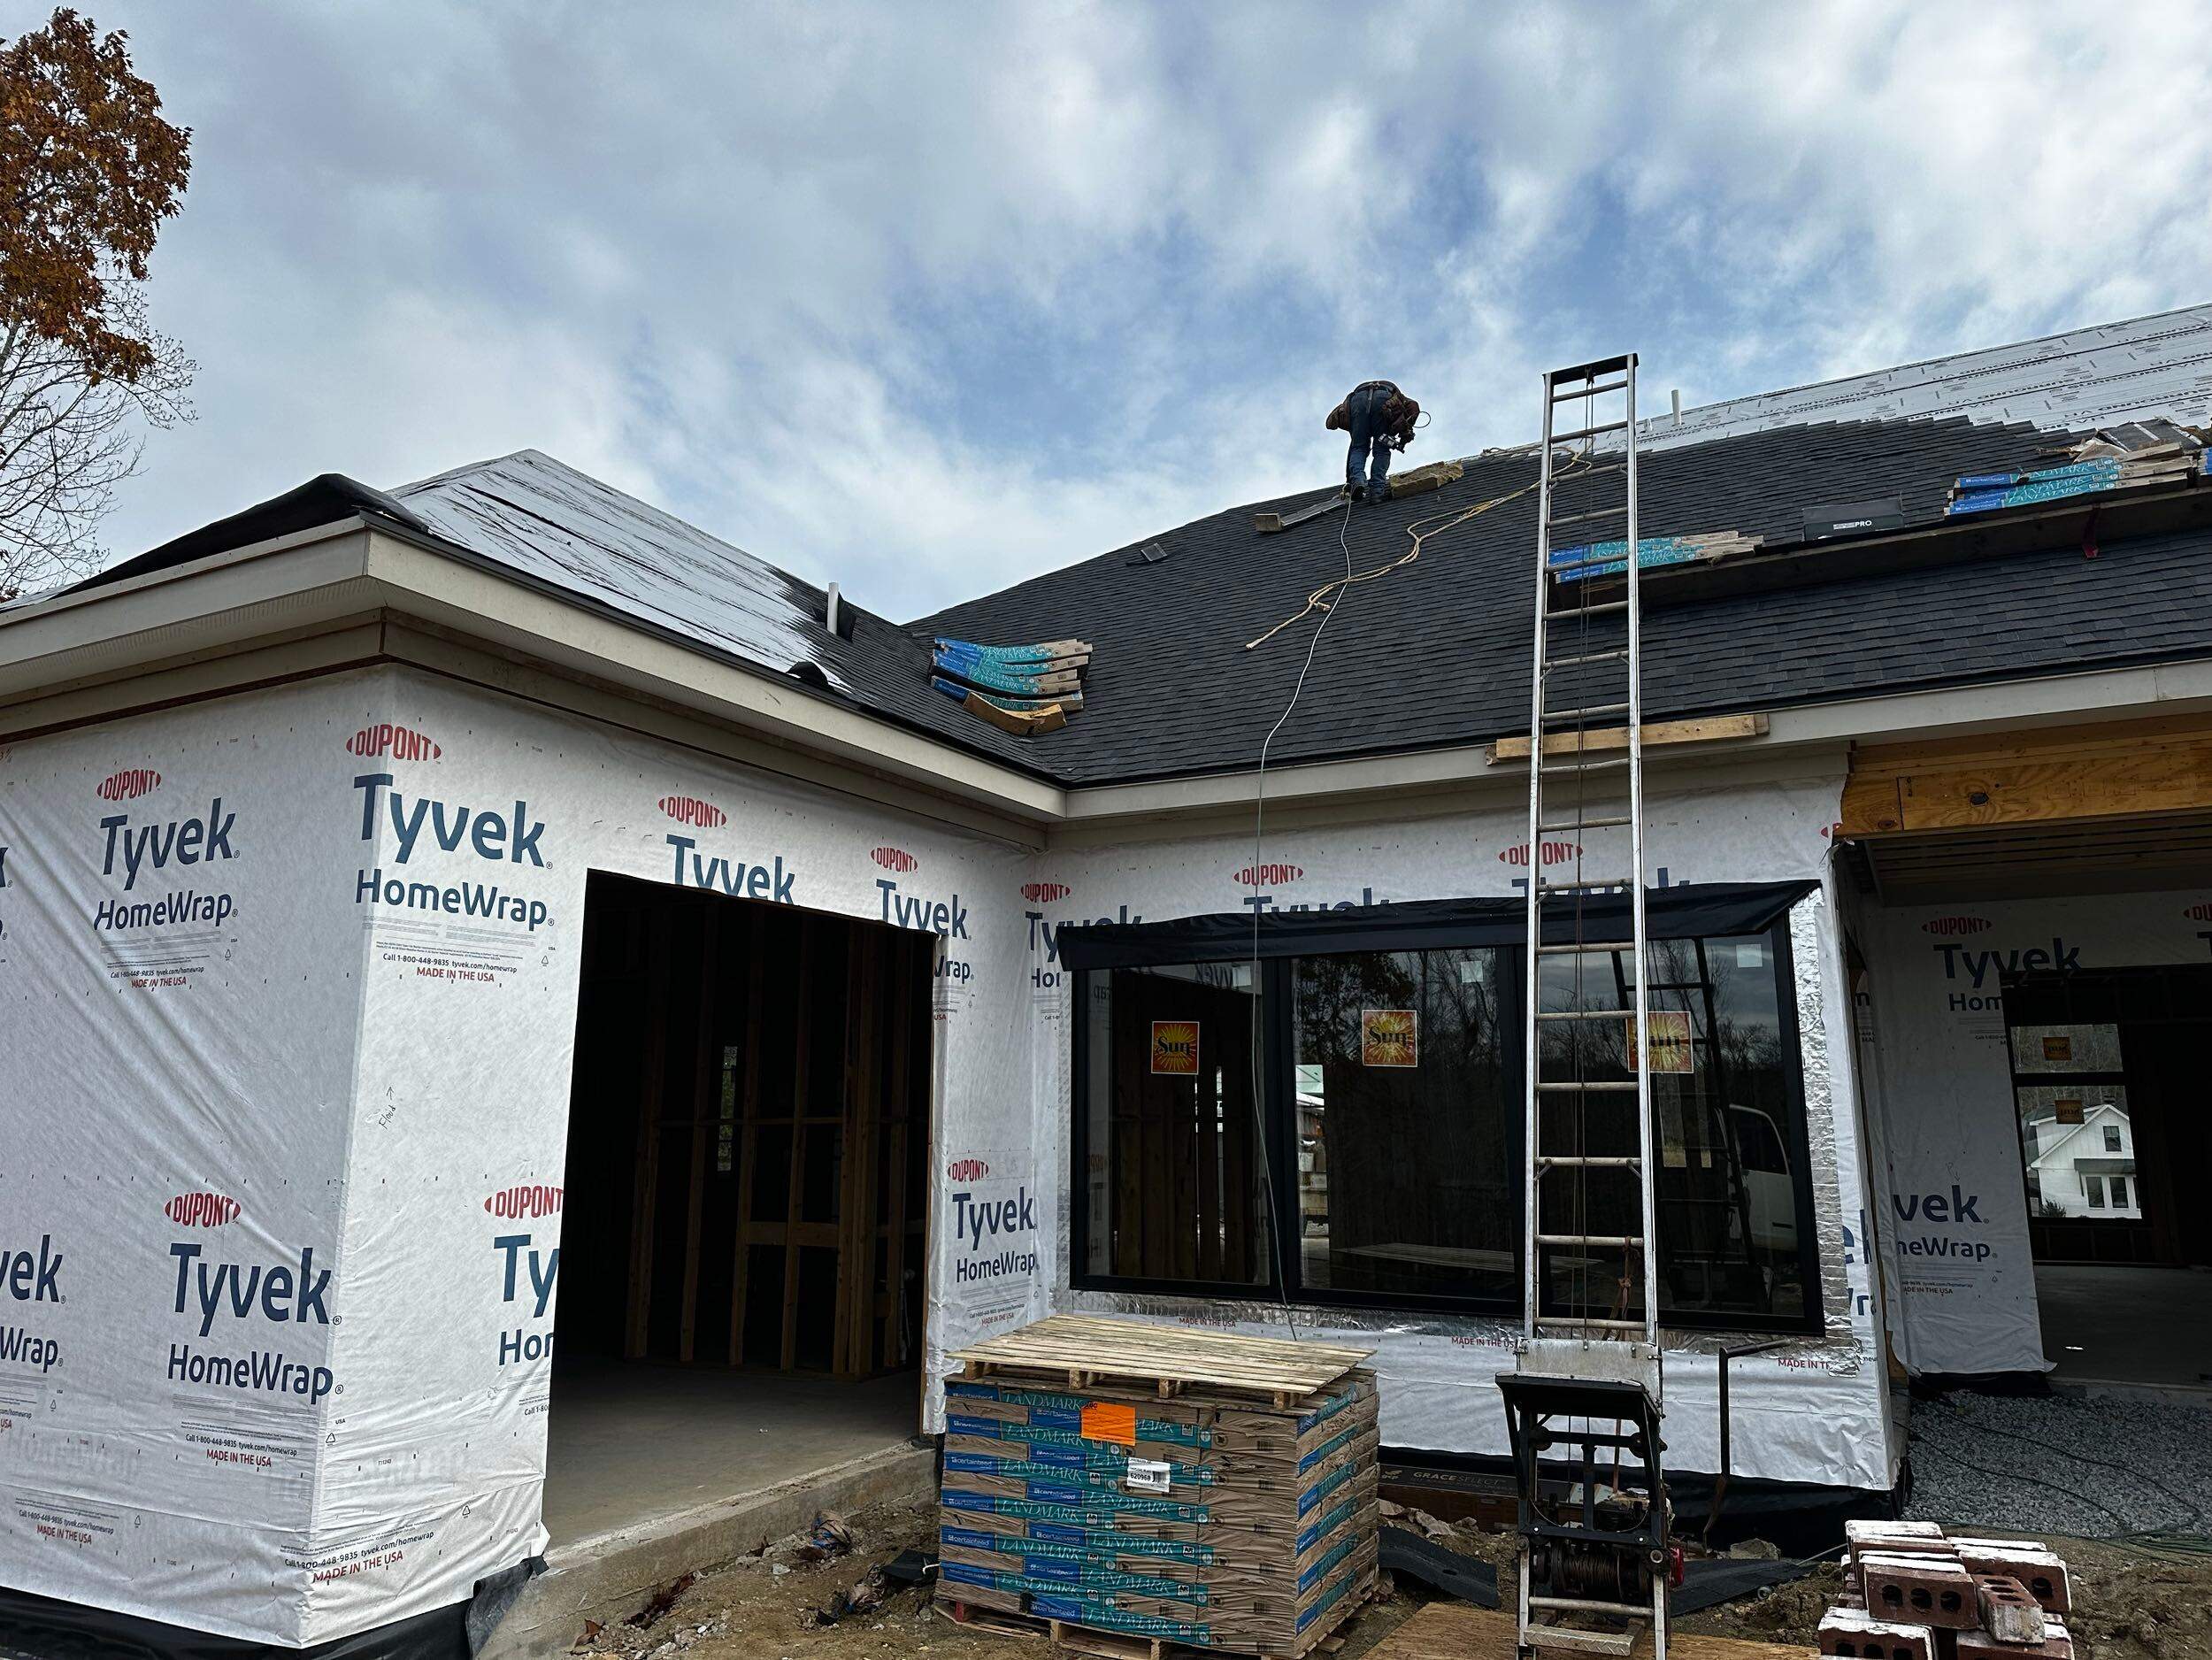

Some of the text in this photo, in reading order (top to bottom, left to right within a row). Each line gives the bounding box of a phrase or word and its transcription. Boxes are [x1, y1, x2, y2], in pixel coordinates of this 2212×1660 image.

[355, 724, 432, 761] DUPONT
[104, 770, 156, 801] DUPONT
[354, 772, 546, 868] Tyvek
[666, 796, 720, 827] DUPONT
[100, 797, 236, 891] Tyvek
[1509, 842, 1573, 866] DUONT
[876, 847, 914, 872] DUPONT
[1242, 864, 1296, 886] DUPONT
[355, 868, 547, 932] HomeWrap
[1025, 884, 1064, 903] DUPONT
[94, 890, 233, 931] HomeWrap
[1931, 917, 1984, 935] DUPONT
[382, 953, 518, 973] Call 1-800-448-9835 tyvek.com/homewrap
[417, 966, 495, 983] MADE IN THE USA
[131, 976, 187, 988] MADE IN THE USA
[1157, 1035, 1191, 1057] Sun
[1368, 1026, 1409, 1047] Sun
[952, 1159, 985, 1182] DUPONT
[173, 1193, 233, 1228] DUPONT
[495, 1186, 565, 1219] DUPONT
[952, 1187, 1033, 1251] Tyvek
[956, 1250, 1035, 1283] HomeWrap
[169, 1242, 332, 1337] Tyvek
[168, 1343, 334, 1405] HomeWrap
[1778, 1358, 1806, 1369] MADE
[1809, 1359, 1817, 1369] IN
[1005, 1394, 1083, 1410] LANDMARK
[186, 1433, 297, 1456] Call 1-800-448-9835 tyvek.com/homewrap
[1005, 1426, 1084, 1447] LANDMARK
[206, 1449, 272, 1467] MADE IN THE USA
[1004, 1460, 1082, 1483] LANDMARK
[1413, 1472, 1458, 1482] GRACE
[1002, 1501, 1079, 1522] LANDMARK
[1087, 1490, 1170, 1515] LANDMARK
[37, 1525, 92, 1545] MADE IN THE USA
[1093, 1533, 1175, 1555] LANDMARK
[284, 1558, 296, 1567] Call
[296, 1552, 358, 1570] 1-800-448-9835
[361, 1531, 434, 1557] tyvek.com/homewrap
[1002, 1539, 1079, 1561] LANDMARK
[312, 1550, 403, 1584] MADE IN THE USA
[1001, 1576, 1079, 1595] LANDMARK
[1087, 1571, 1171, 1592] LANDMARK
[1087, 1610, 1171, 1633] LANDMARK
